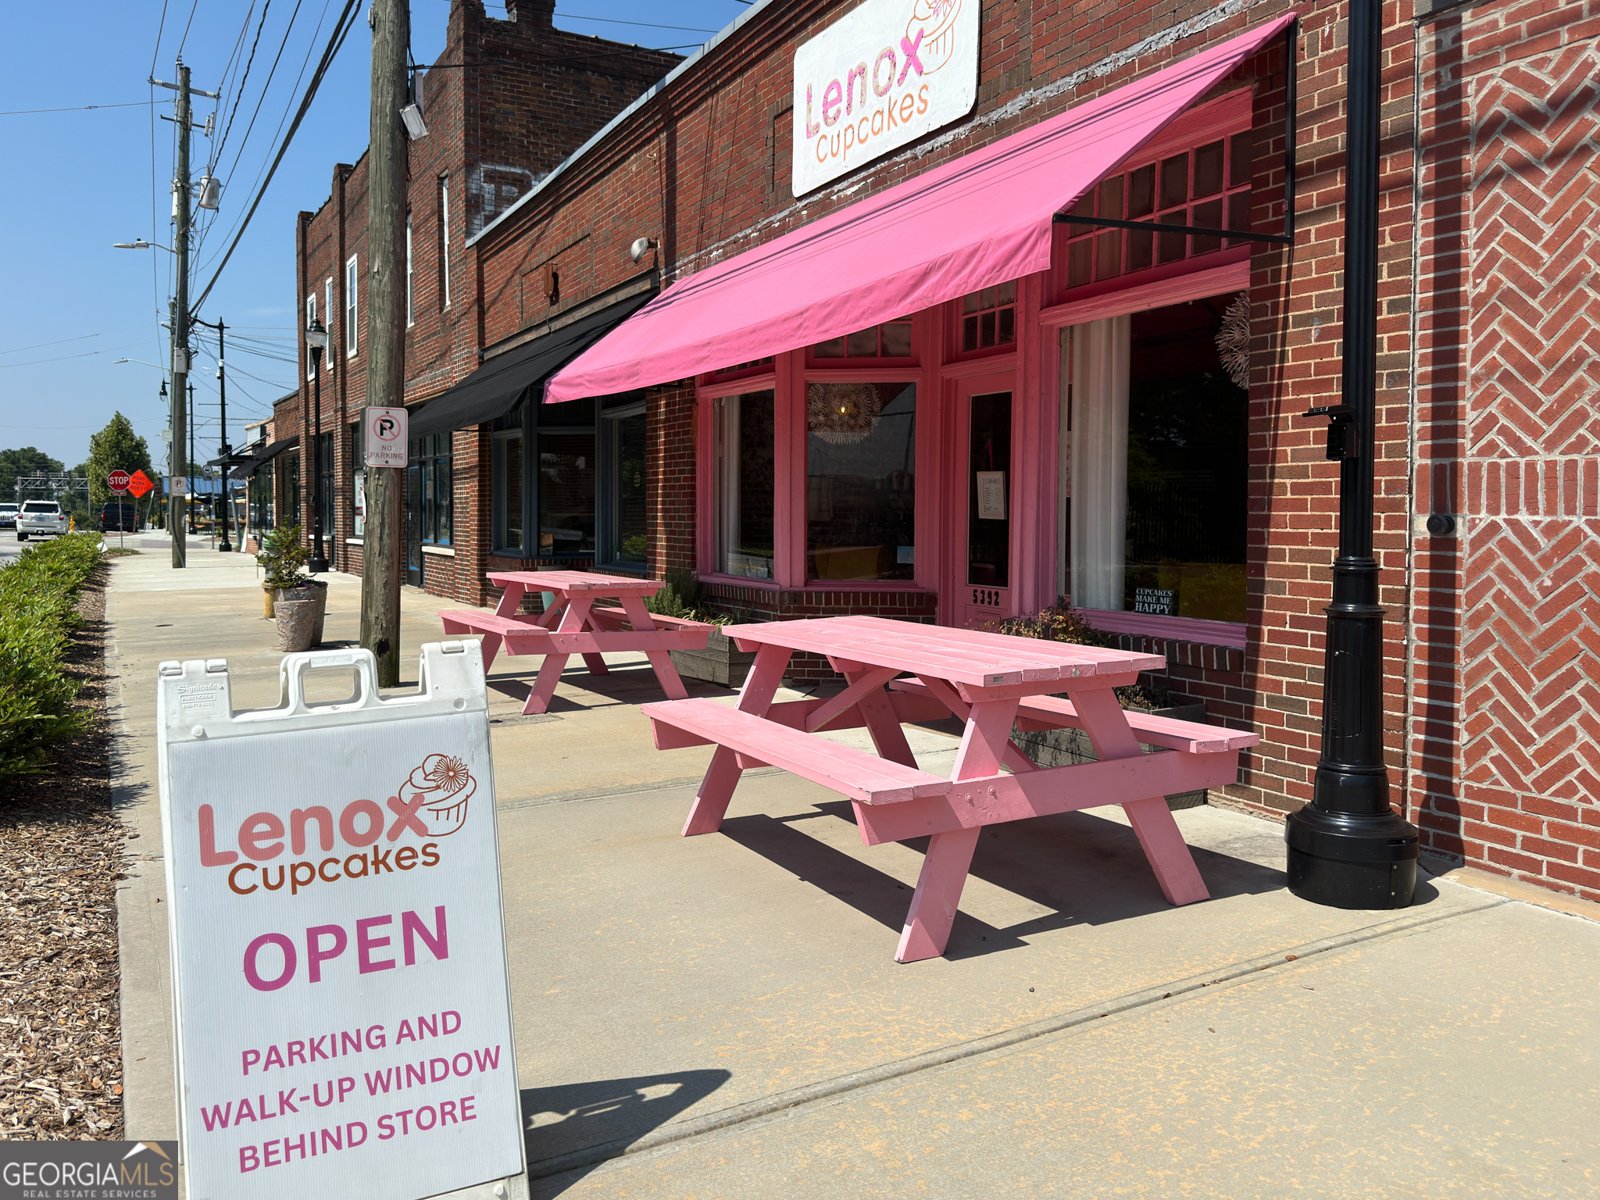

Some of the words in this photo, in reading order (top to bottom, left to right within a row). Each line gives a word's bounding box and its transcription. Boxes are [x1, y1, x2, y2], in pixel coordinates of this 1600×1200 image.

[806, 28, 924, 139] Lenox
[109, 476, 129, 485] STOP
[370, 451, 403, 460] PARKING
[972, 588, 1000, 606] 5392
[1135, 587, 1172, 597] CUPCAKES
[1135, 594, 1157, 604] MAKE
[1160, 596, 1172, 604] ME
[1135, 602, 1172, 615] HAPPY
[198, 792, 429, 868] Lenox
[228, 842, 441, 895] Cupcakes
[243, 905, 449, 992] OPEN
[242, 1024, 388, 1076] PARKING
[396, 1010, 462, 1045] AND
[201, 1077, 357, 1132] WALK-UP
[365, 1045, 501, 1096] WINDOW
[239, 1121, 369, 1173] BEHIND
[377, 1095, 477, 1140] STORE
